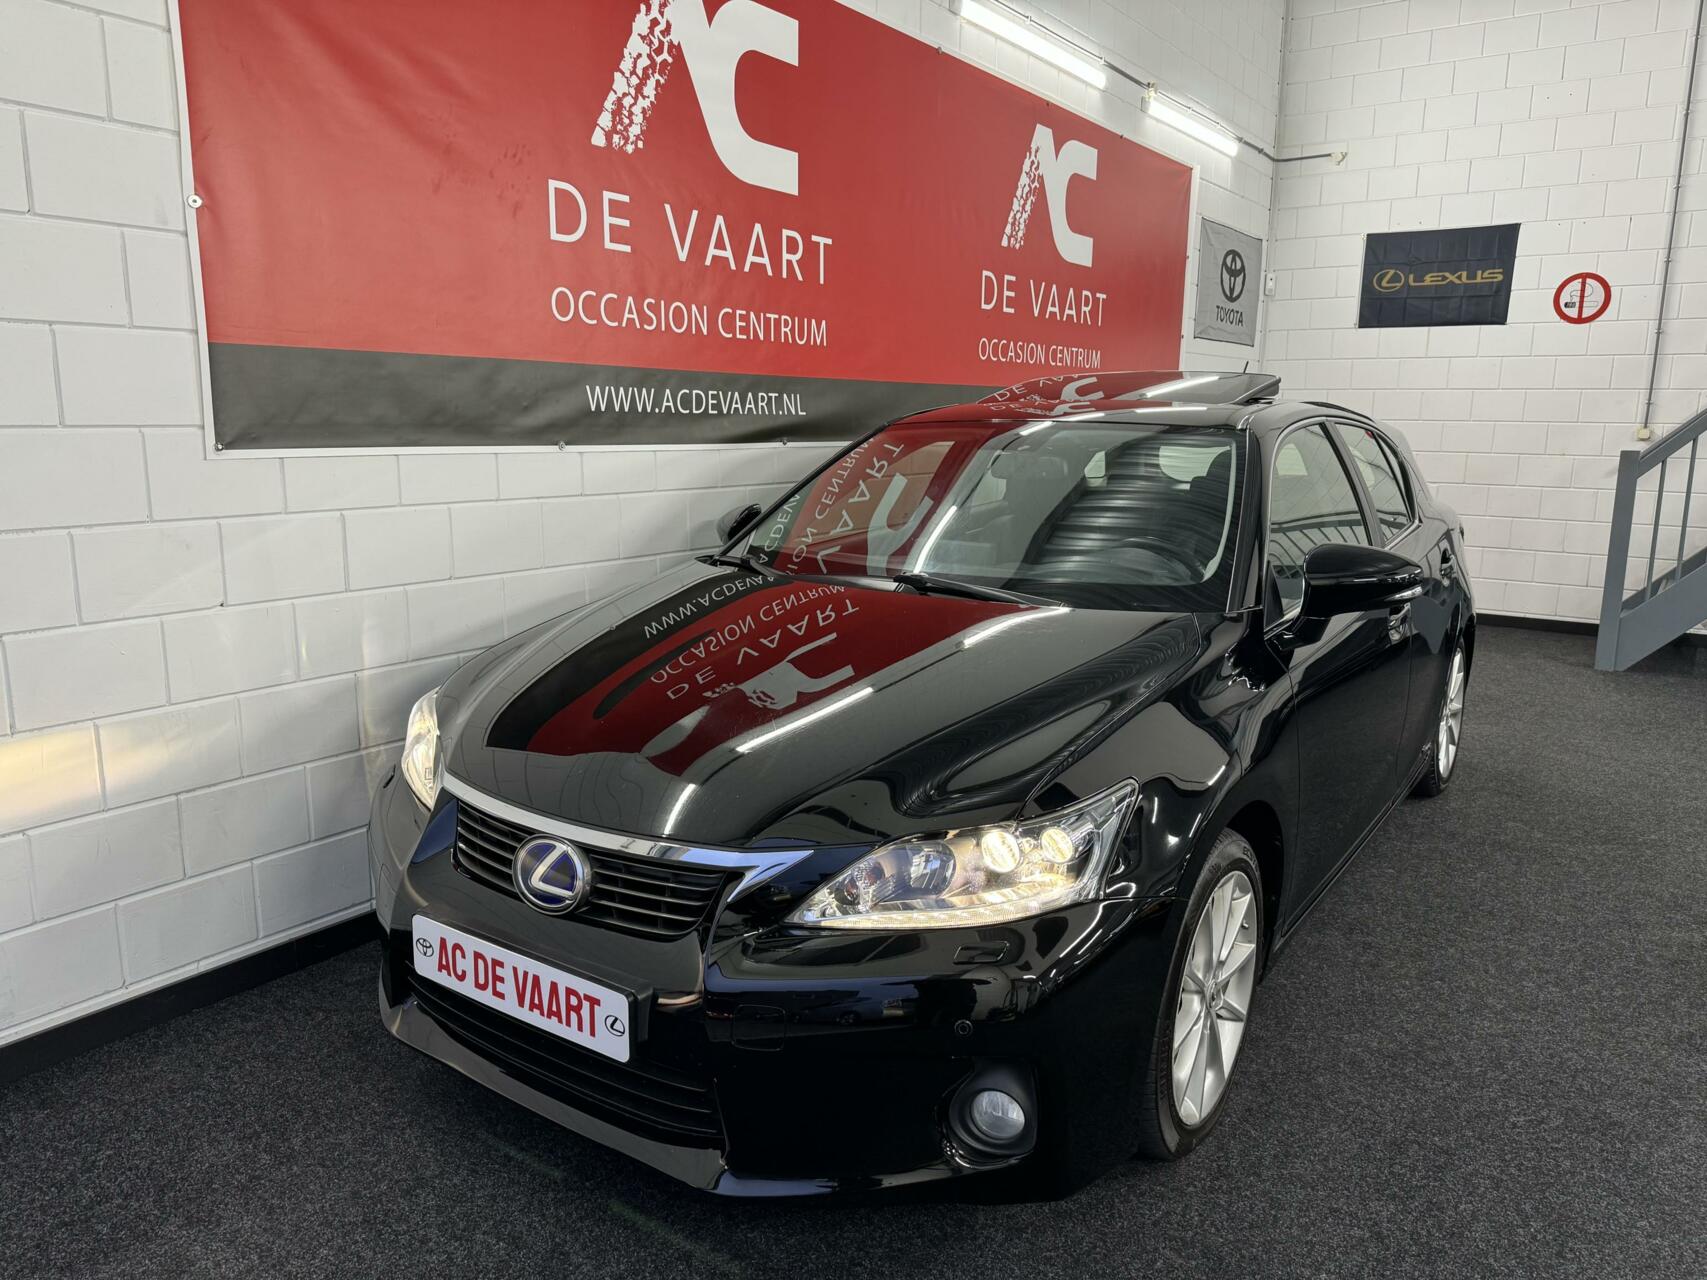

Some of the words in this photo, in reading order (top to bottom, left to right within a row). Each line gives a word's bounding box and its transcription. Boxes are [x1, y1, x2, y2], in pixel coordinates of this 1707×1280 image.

[547, 178, 632, 253] DE
[664, 203, 833, 285] VAART
[980, 270, 1016, 314] DE
[1029, 279, 1107, 327] VAART
[1407, 268, 1504, 287] LEXUS
[551, 286, 708, 336] OCCASION
[717, 307, 827, 347] CENTRUM
[1215, 305, 1244, 327] TOYOTA
[978, 337, 1046, 365] OCCASION
[1049, 344, 1101, 369] CENTRUM
[585, 384, 807, 416] WWW.ACDEVAART.NL
[437, 936, 467, 983] AC
[473, 950, 506, 1001] DE
[512, 964, 601, 1039] VAART
